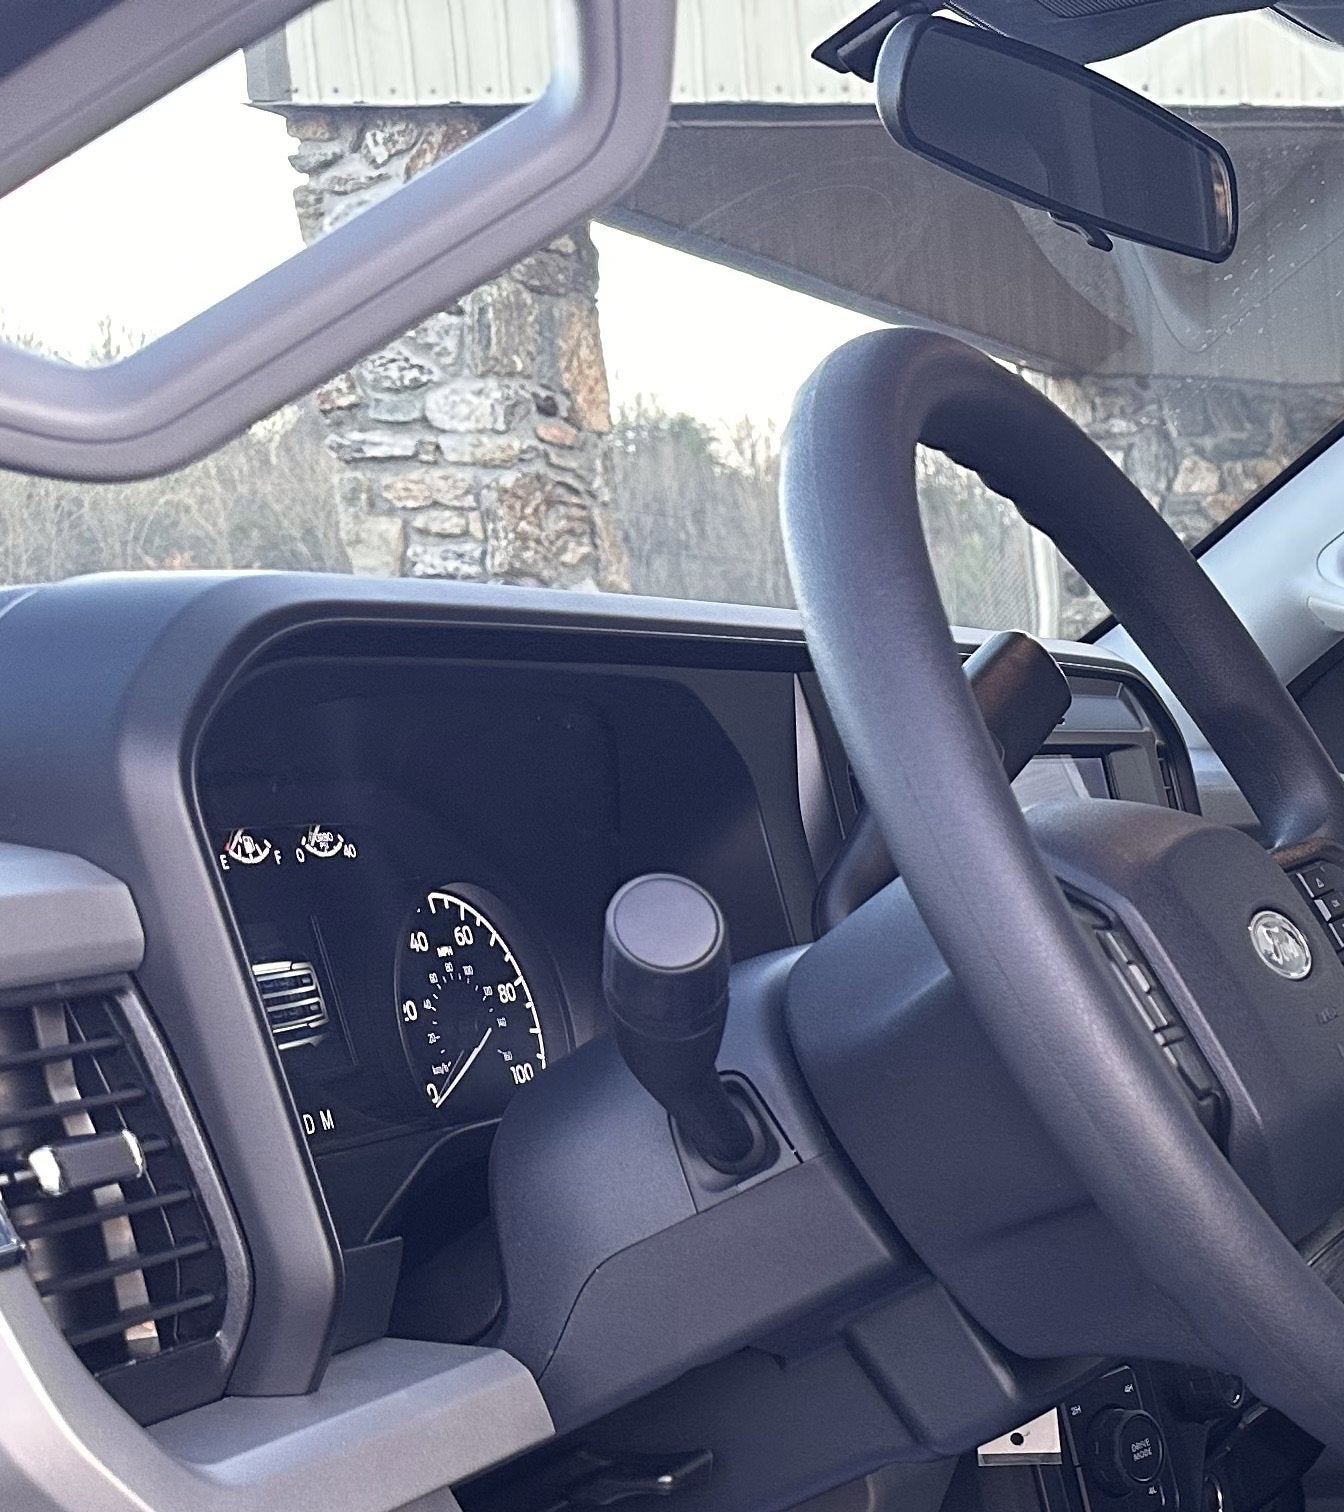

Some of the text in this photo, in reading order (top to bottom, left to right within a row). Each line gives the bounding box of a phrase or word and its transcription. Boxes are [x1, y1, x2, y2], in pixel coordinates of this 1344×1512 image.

[219, 855, 230, 870] E
[274, 850, 282, 865] F
[296, 848, 305, 863] 0
[410, 931, 429, 953] 40
[454, 925, 474, 947] 60
[436, 945, 454, 958] MPH
[497, 982, 517, 1004] 80
[510, 1062, 535, 1085] 100
[303, 1108, 335, 1135] D M
[1130, 1437, 1151, 1453] DRIVE
[1132, 1447, 1153, 1462] MODE
